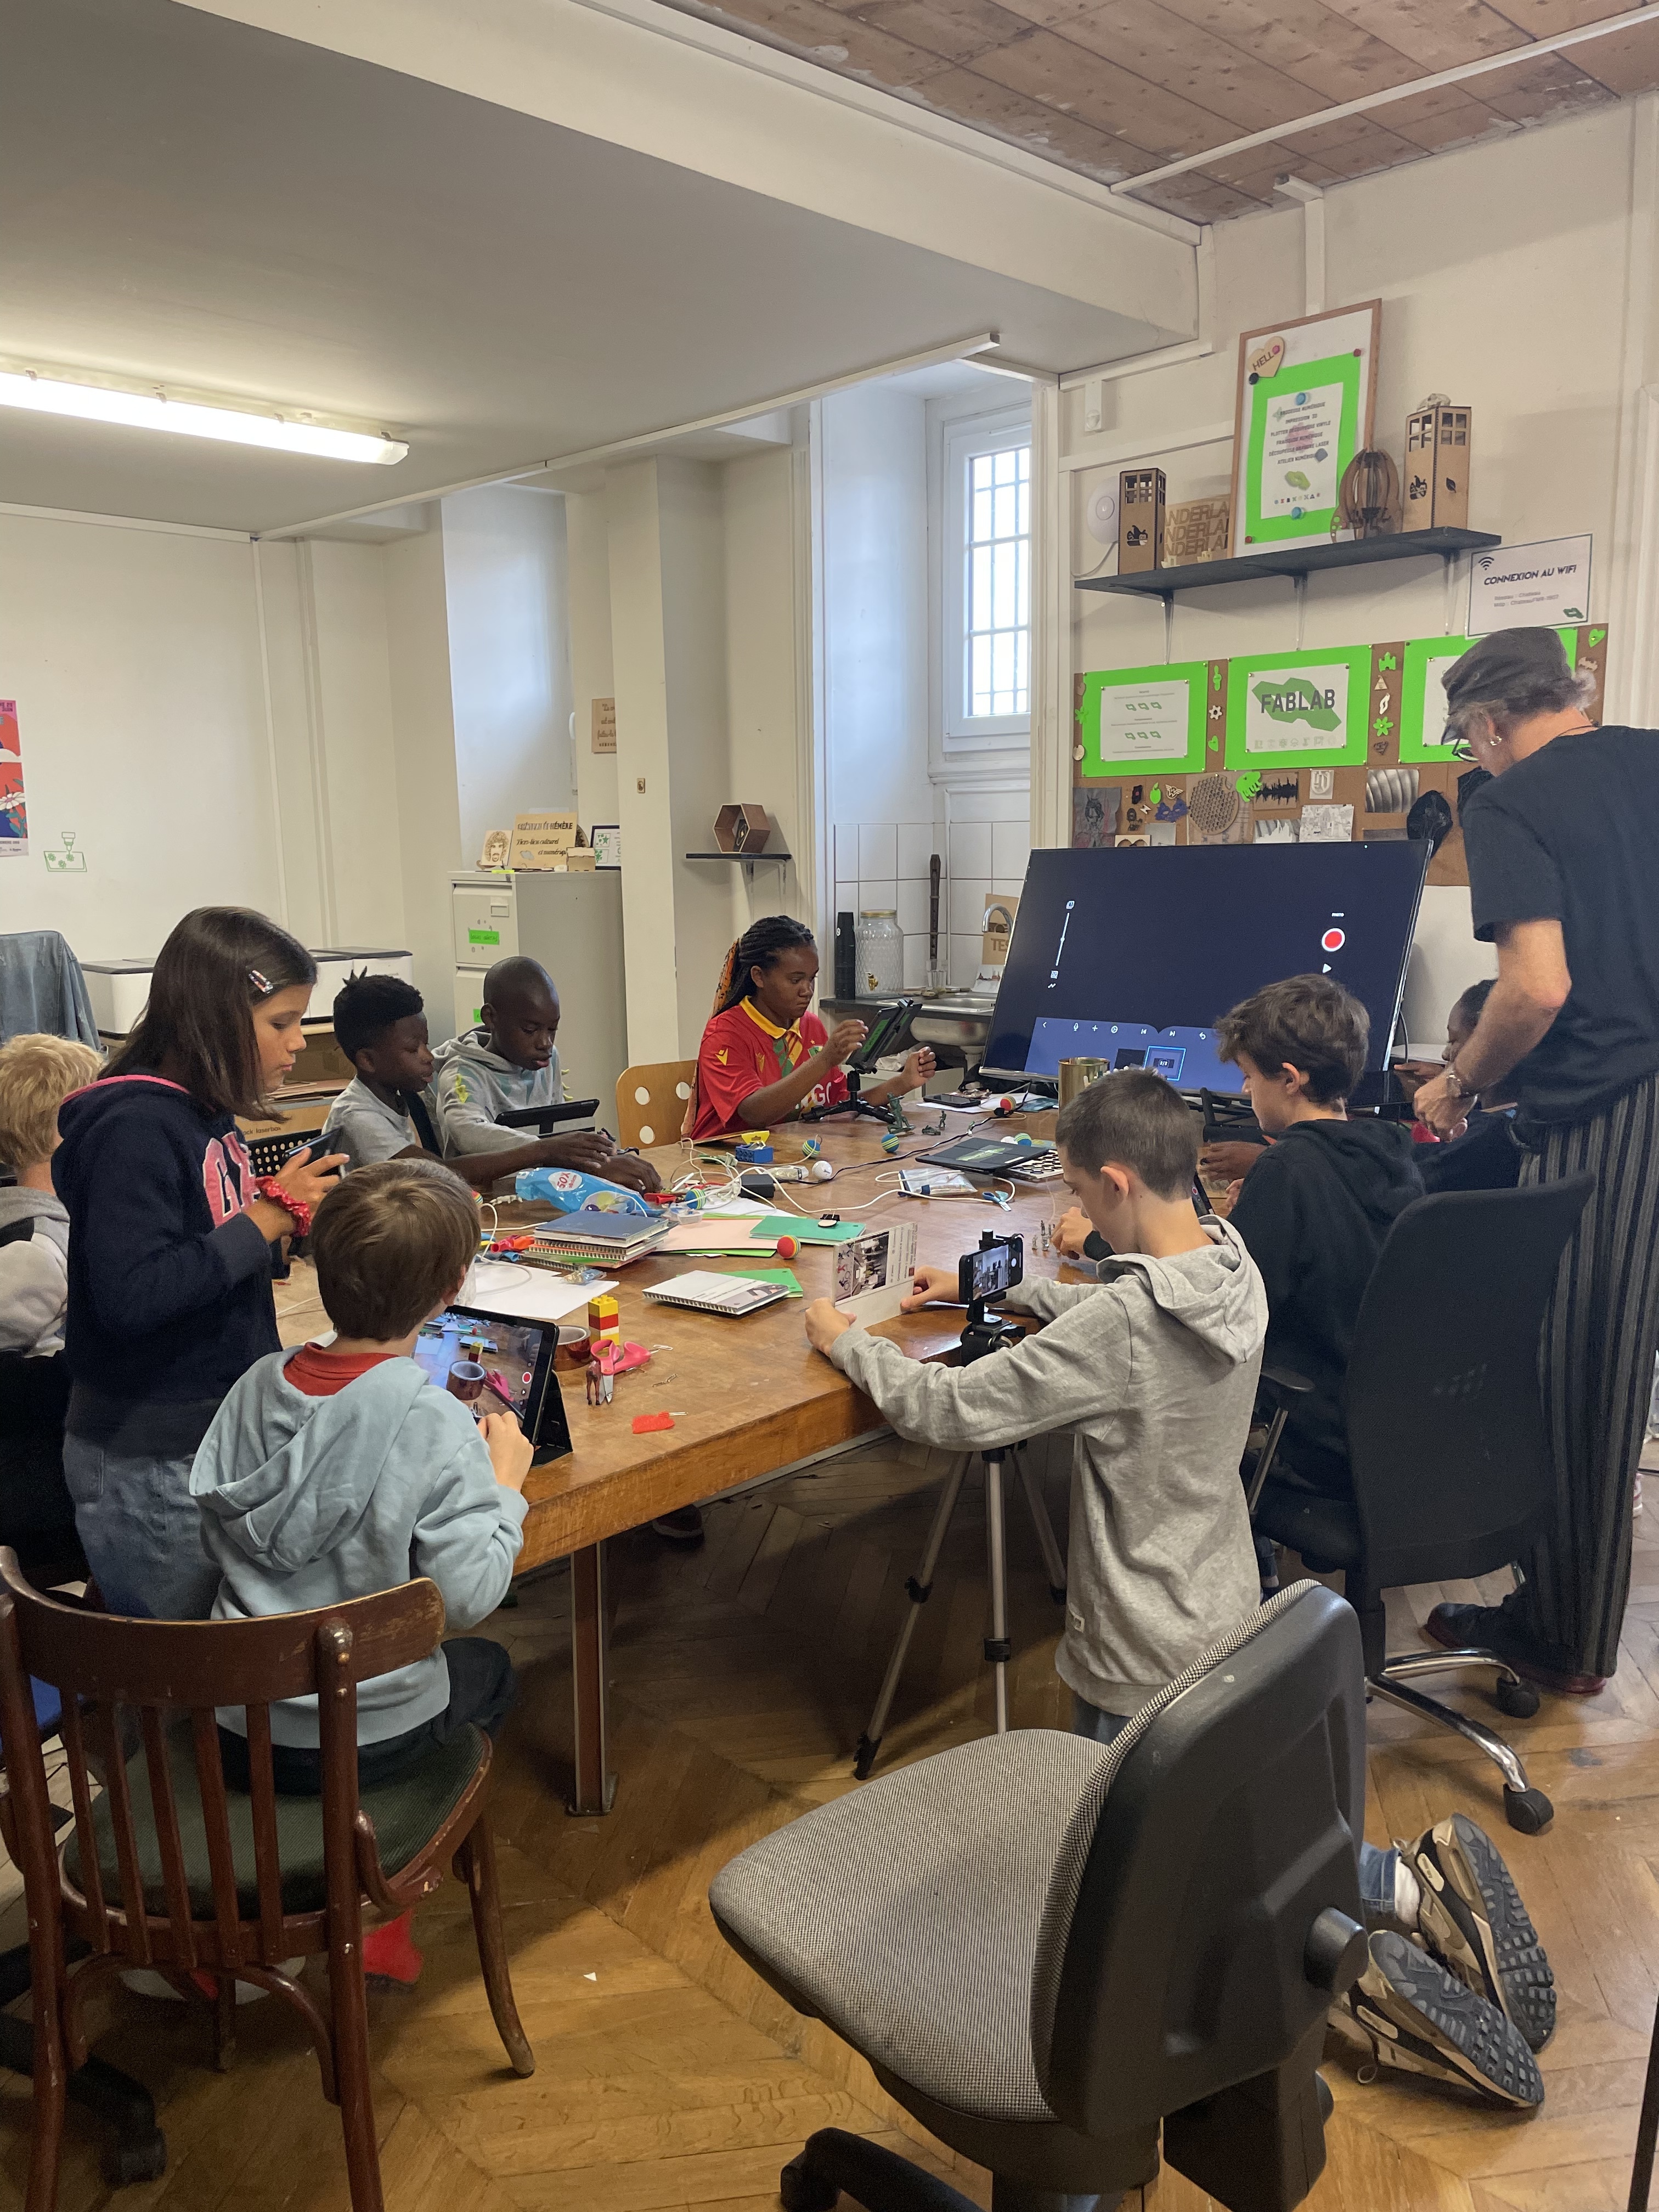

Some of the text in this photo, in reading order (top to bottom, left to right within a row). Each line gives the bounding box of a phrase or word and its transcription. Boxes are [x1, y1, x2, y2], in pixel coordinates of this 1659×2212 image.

[1252, 349, 1277, 371] HELL
[1484, 565, 1577, 585] CONNEXION AU WIFI
[1261, 689, 1335, 714] FABLAB
